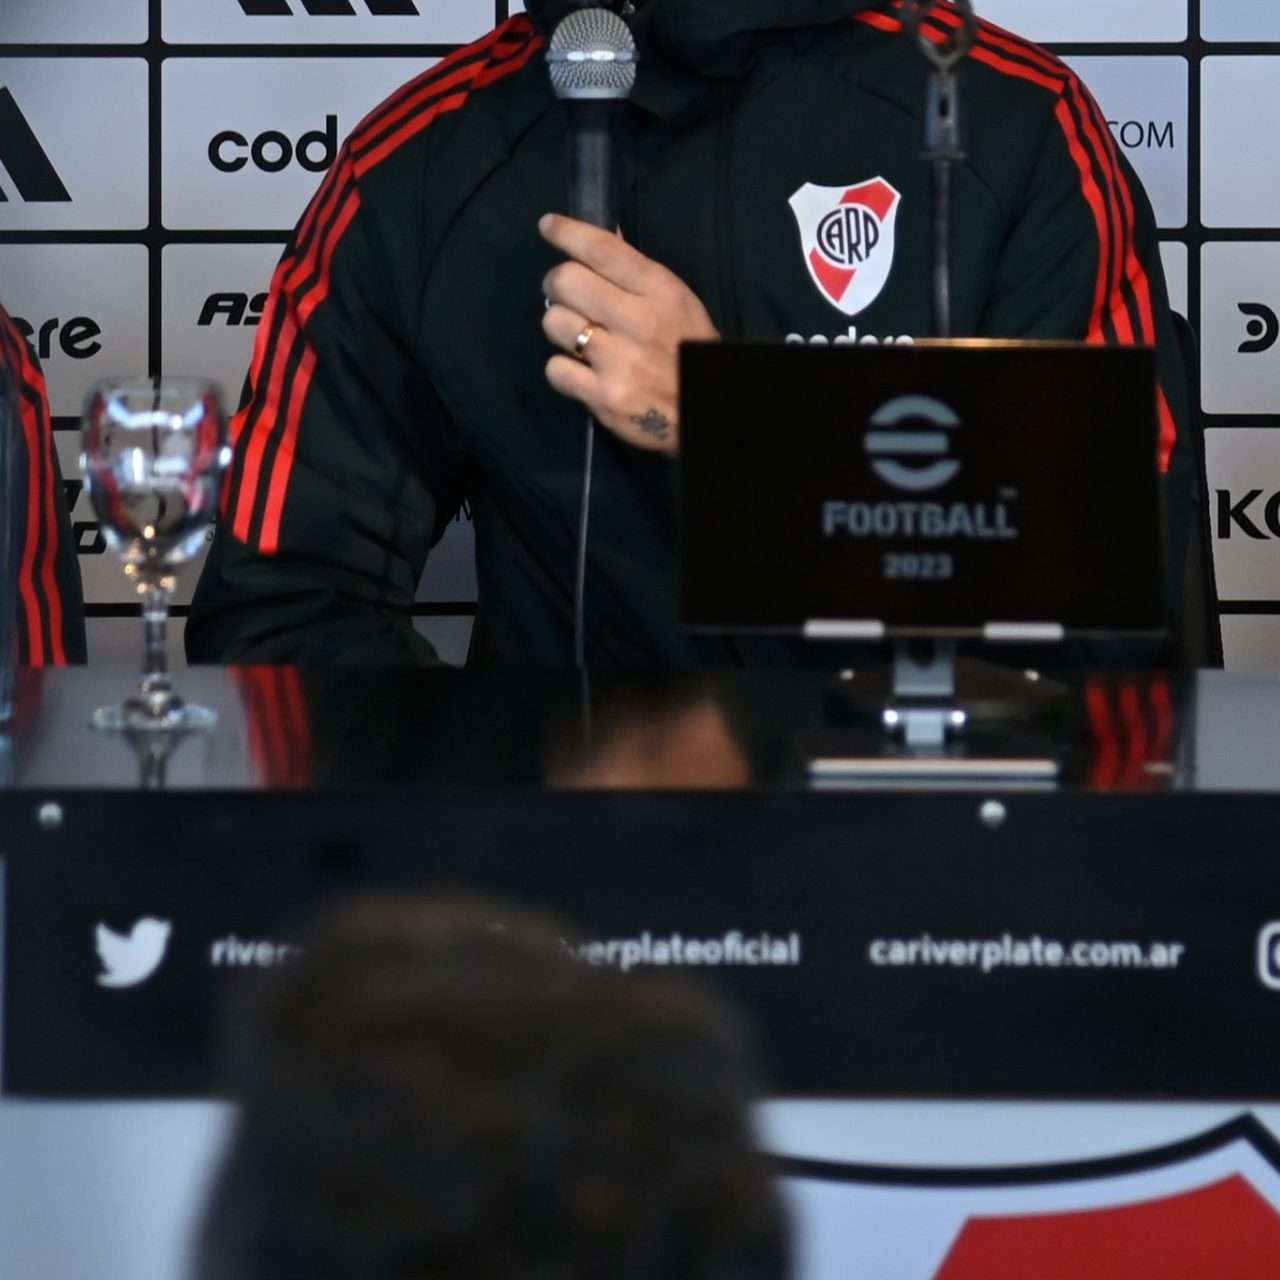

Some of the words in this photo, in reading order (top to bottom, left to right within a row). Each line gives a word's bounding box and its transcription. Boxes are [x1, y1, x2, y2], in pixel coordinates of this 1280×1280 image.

[207, 114, 338, 173] cod
[823, 502, 1017, 538] FOOTBALL
[883, 553, 953, 579] 2023
[869, 934, 1184, 971] cariverplate.com.ar
